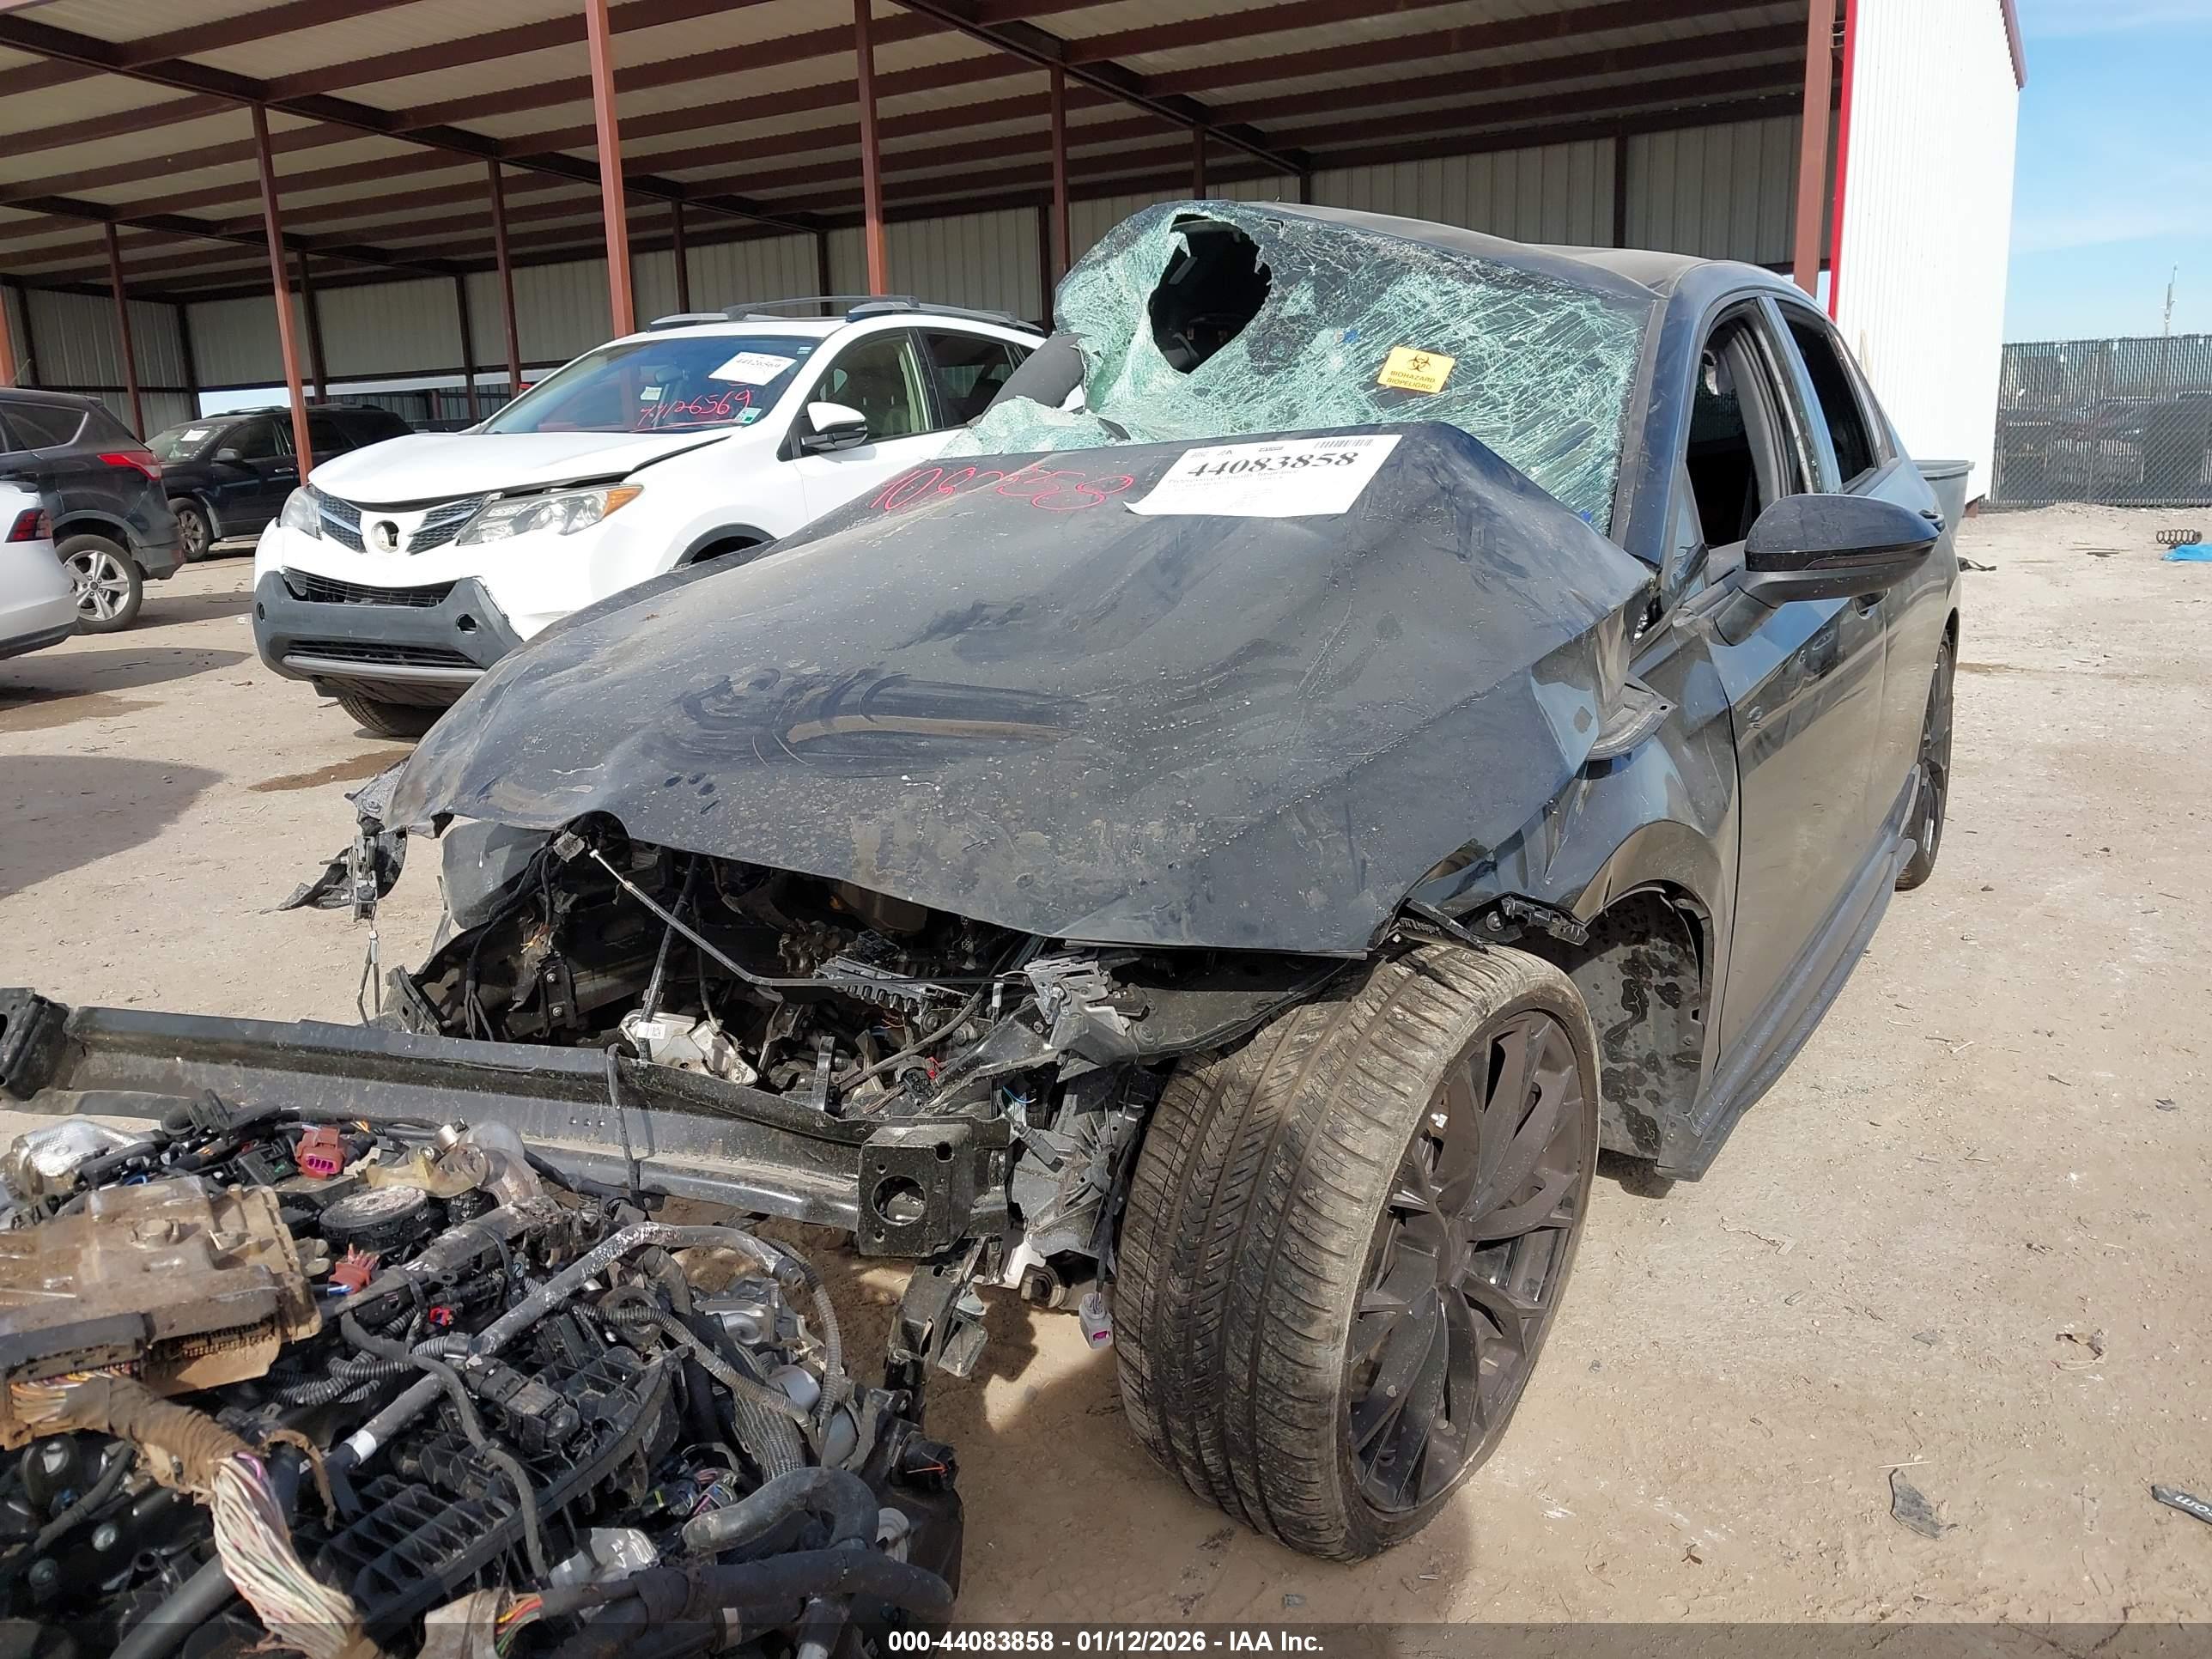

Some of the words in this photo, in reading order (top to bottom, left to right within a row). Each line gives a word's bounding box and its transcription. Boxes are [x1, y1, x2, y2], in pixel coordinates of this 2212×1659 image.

[1389, 370, 1436, 383] BIOHAZARD
[1386, 377, 1433, 390] BIOPELIGRO
[1187, 451, 1359, 477] 44083858
